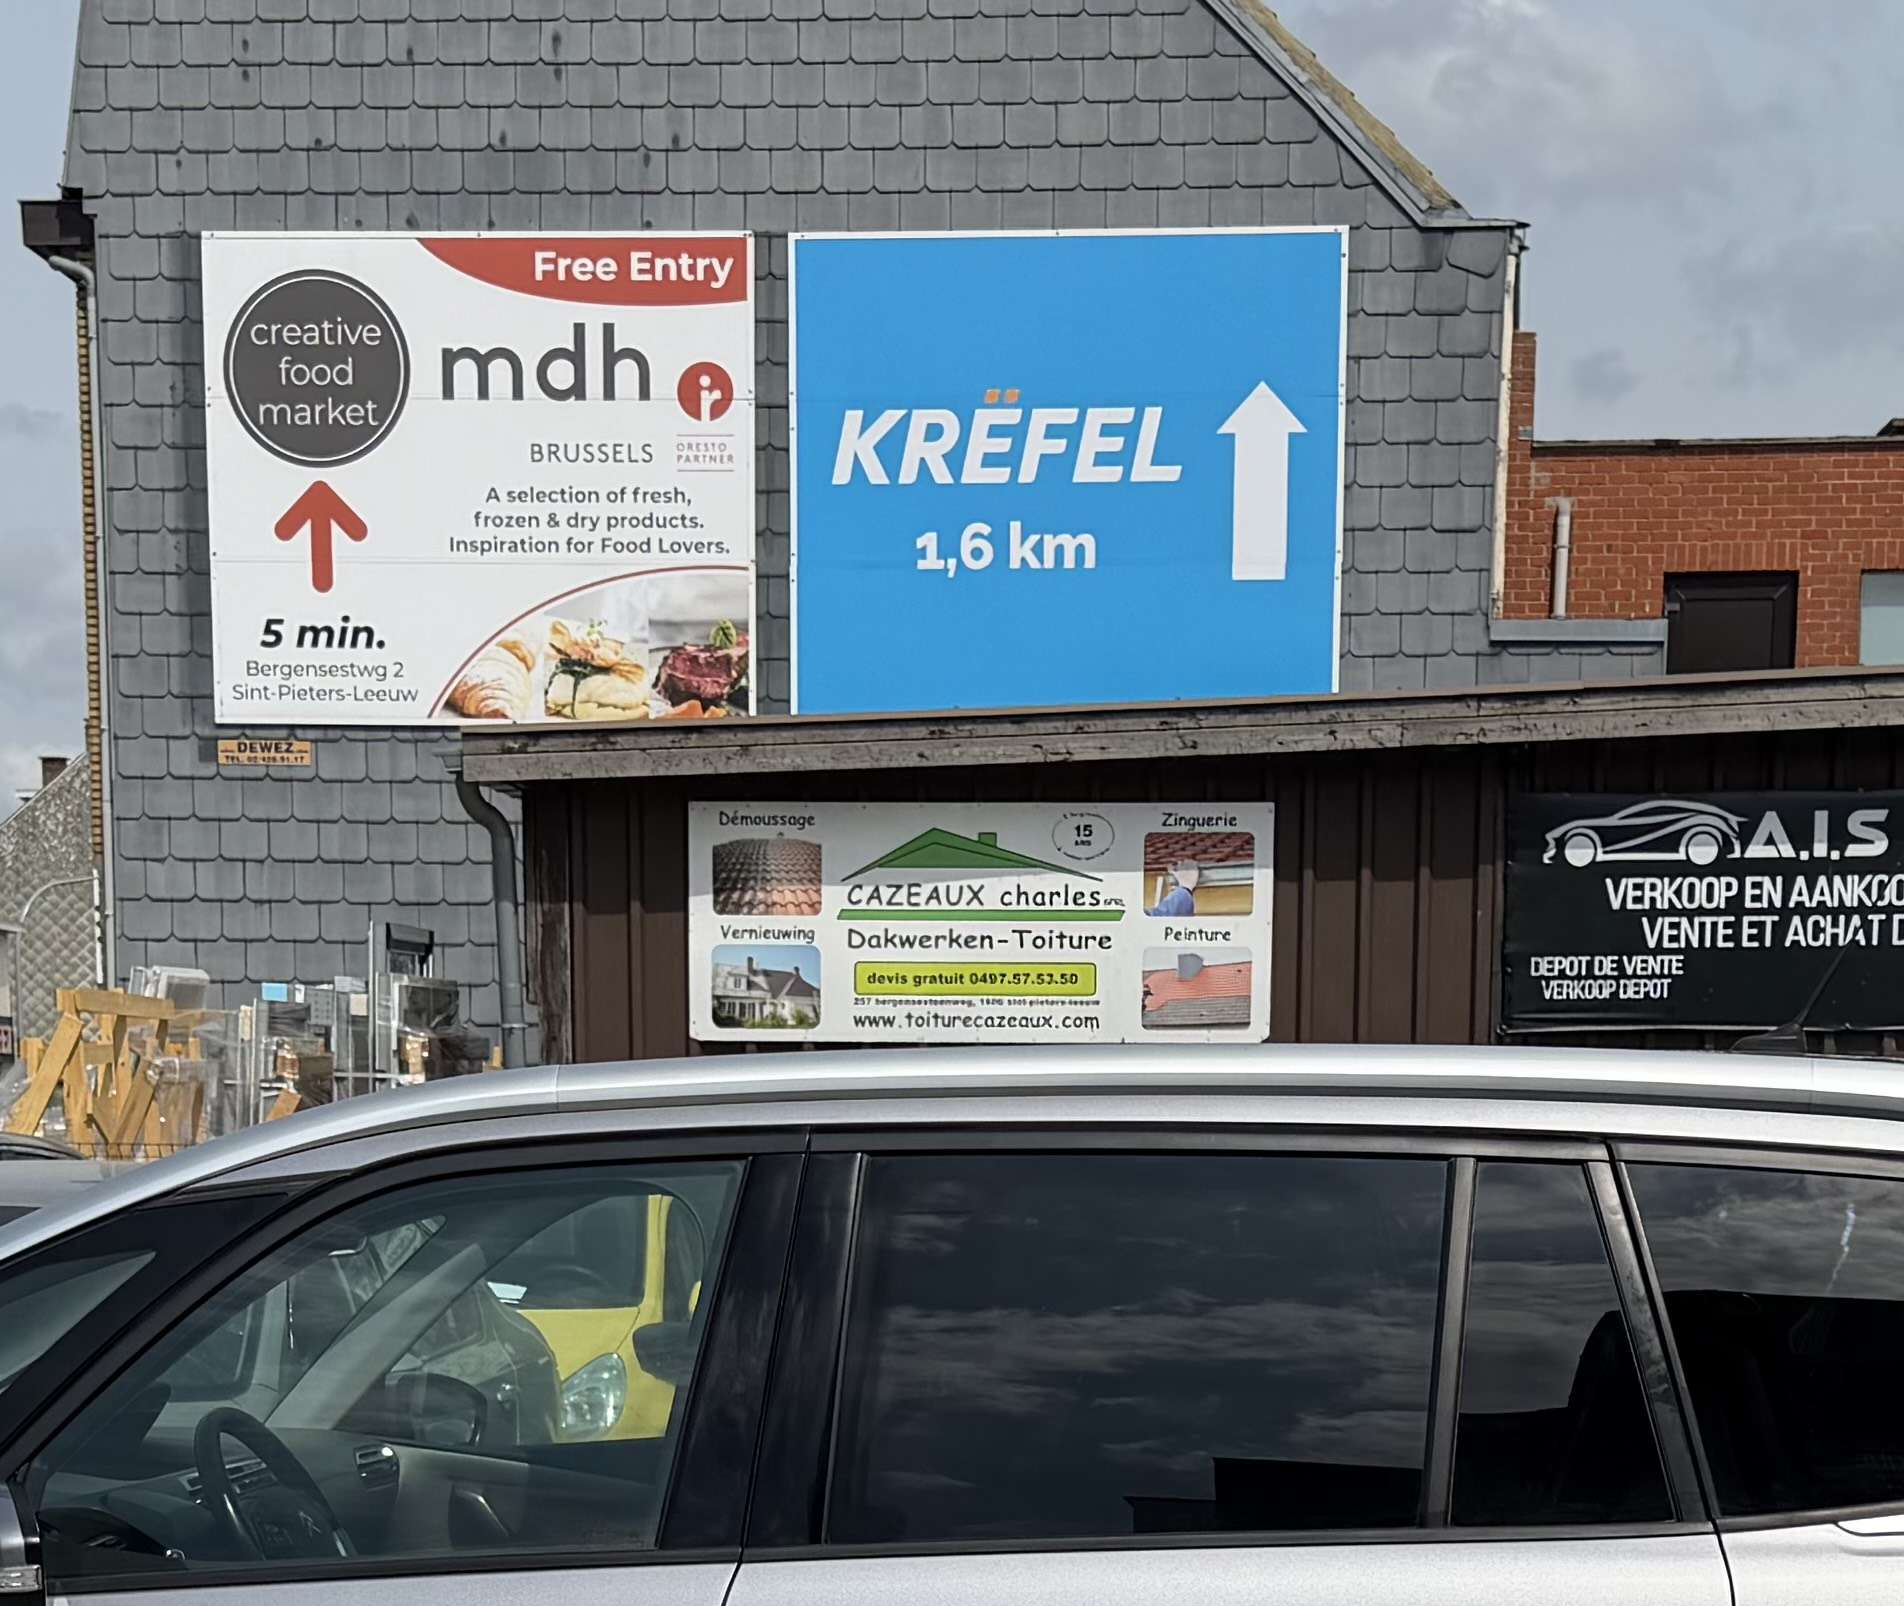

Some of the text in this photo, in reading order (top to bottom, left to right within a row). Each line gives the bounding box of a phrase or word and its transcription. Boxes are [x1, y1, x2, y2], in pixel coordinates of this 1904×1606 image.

[533, 251, 735, 289] Free Entry
[250, 316, 382, 346] creative
[278, 355, 353, 386] food
[441, 322, 651, 402] mdh
[258, 396, 379, 426] market
[831, 388, 1183, 485] KRËFEL
[529, 443, 654, 464] BRUSSELS
[676, 442, 728, 453] ORESTO
[676, 454, 735, 465] PARTNER
[485, 486, 693, 507] A selection of fresh,
[473, 511, 705, 532] frozen & dry products.
[449, 536, 731, 557] Inspiration for Food Lovers.
[915, 520, 1098, 578] 1,6 km
[259, 614, 386, 650] 5 min.
[245, 659, 405, 682] Bergensestwg 2
[232, 683, 419, 702] Sint-Pieters-Leeuw
[237, 742, 294, 754] DEWEZ
[719, 810, 816, 831] Démoussage
[1075, 824, 1093, 837] 15
[1161, 812, 1238, 831] Zinguerie
[847, 883, 1102, 907] CAZEAUX charles
[1605, 876, 1738, 911] VERKOOP
[1744, 876, 1783, 909] EN
[720, 924, 816, 944] Vernieuwing
[847, 928, 1113, 950] Dakwerken-Toiture
[1164, 926, 1232, 942] Peinture
[1641, 917, 1734, 949] VENTE
[1741, 916, 1779, 947] ET
[1784, 913, 1885, 947] ACHAT
[1531, 955, 1685, 977] DEPOT DE VENTE
[867, 973, 908, 985] devis
[913, 973, 964, 988] gratuit
[1542, 978, 1672, 1000] VERKOOP DEPOT
[853, 1012, 1100, 1028] www.toiturecazeaux.com
